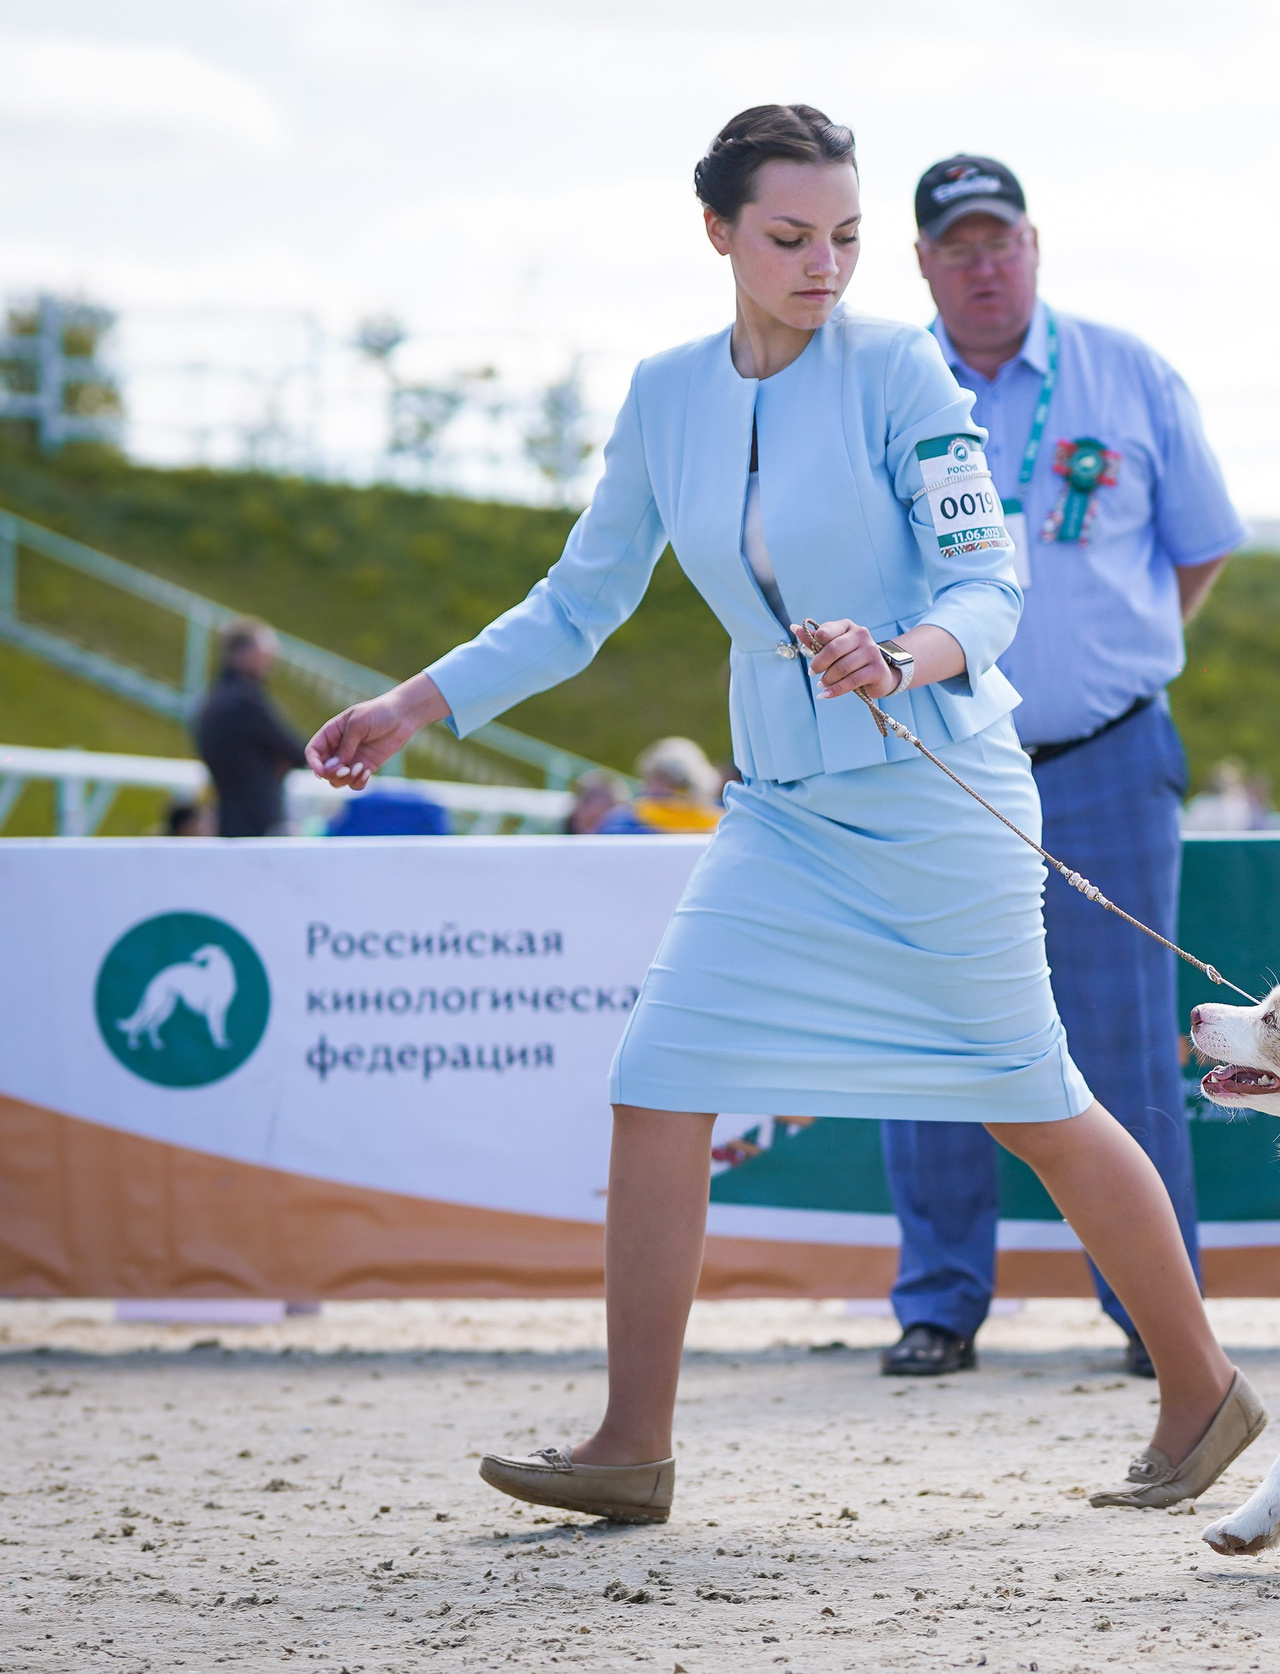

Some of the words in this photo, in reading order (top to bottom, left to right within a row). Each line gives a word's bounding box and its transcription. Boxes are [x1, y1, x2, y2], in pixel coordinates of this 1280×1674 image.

[939, 491, 995, 520] 0019
[305, 921, 565, 959] Российская
[305, 1034, 556, 1081] федерация
